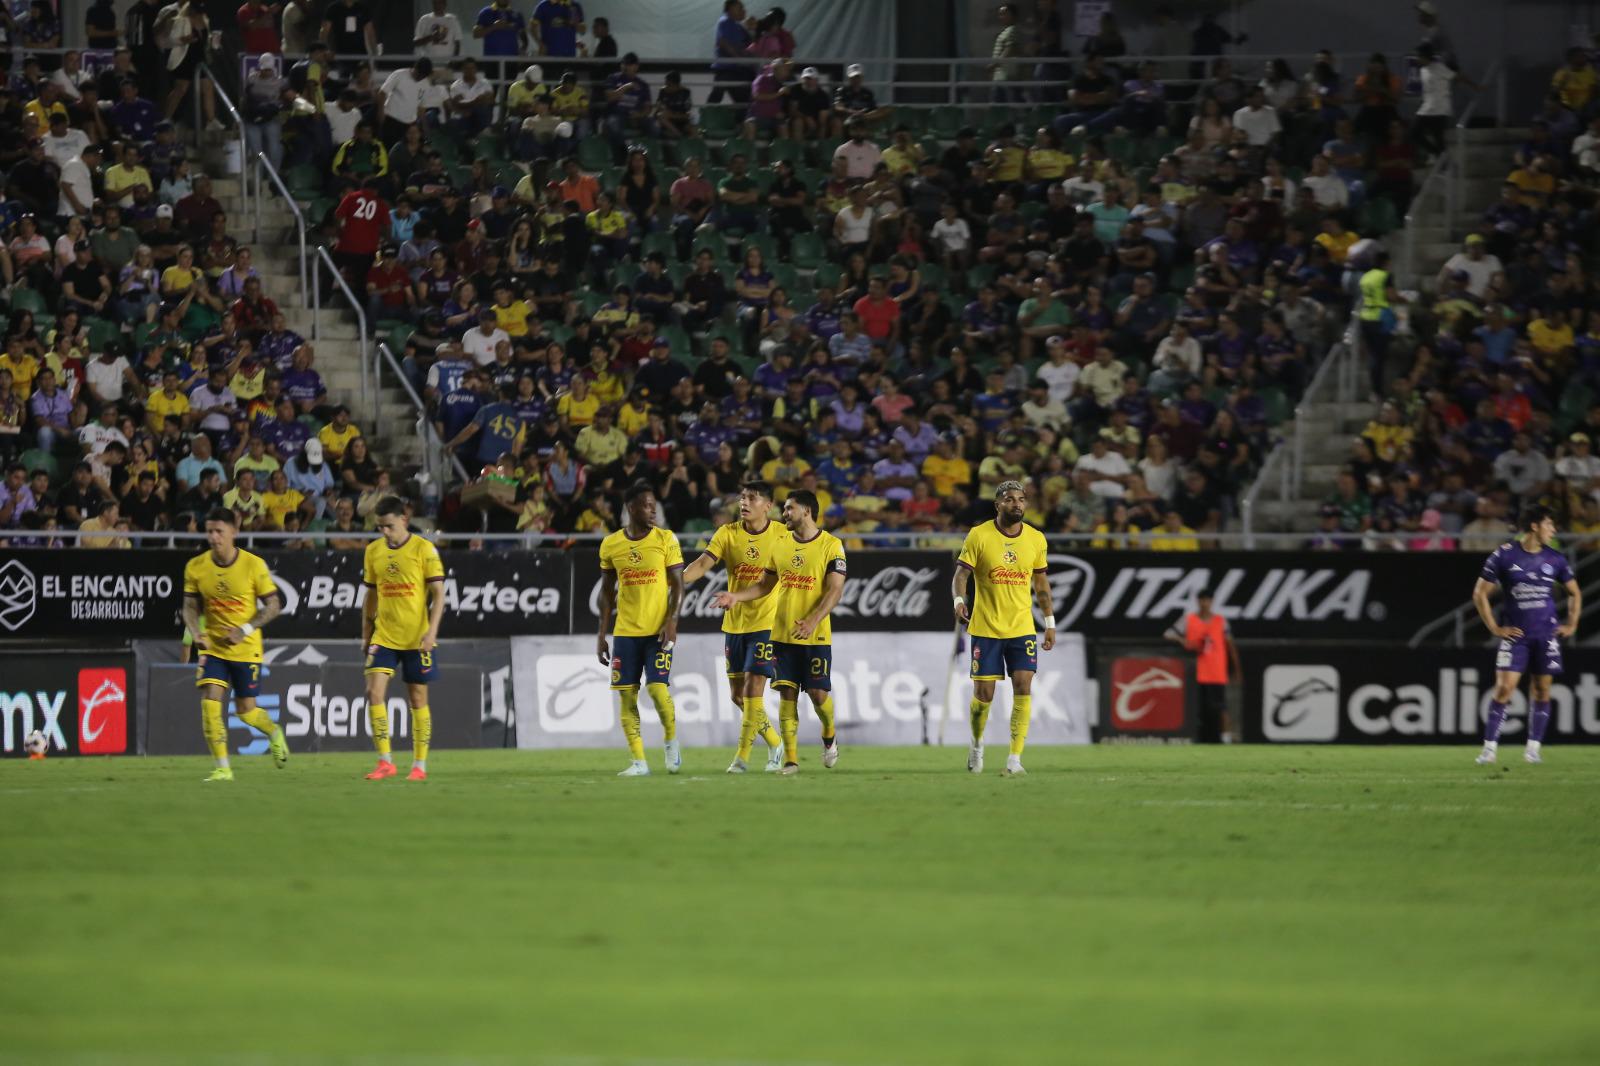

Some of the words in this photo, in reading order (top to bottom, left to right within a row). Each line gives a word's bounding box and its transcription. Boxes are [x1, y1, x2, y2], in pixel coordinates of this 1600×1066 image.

[353, 197, 377, 220] 20
[488, 414, 516, 440] 45
[42, 575, 66, 598] EL
[71, 575, 173, 598] ENCANTO
[430, 578, 560, 614] Azteca
[1092, 567, 1371, 620] ITALIKA
[71, 600, 145, 620] DESARROLLOS
[655, 652, 672, 670] 26
[754, 643, 774, 661] 32
[248, 664, 259, 681] 7
[811, 657, 828, 676] 21
